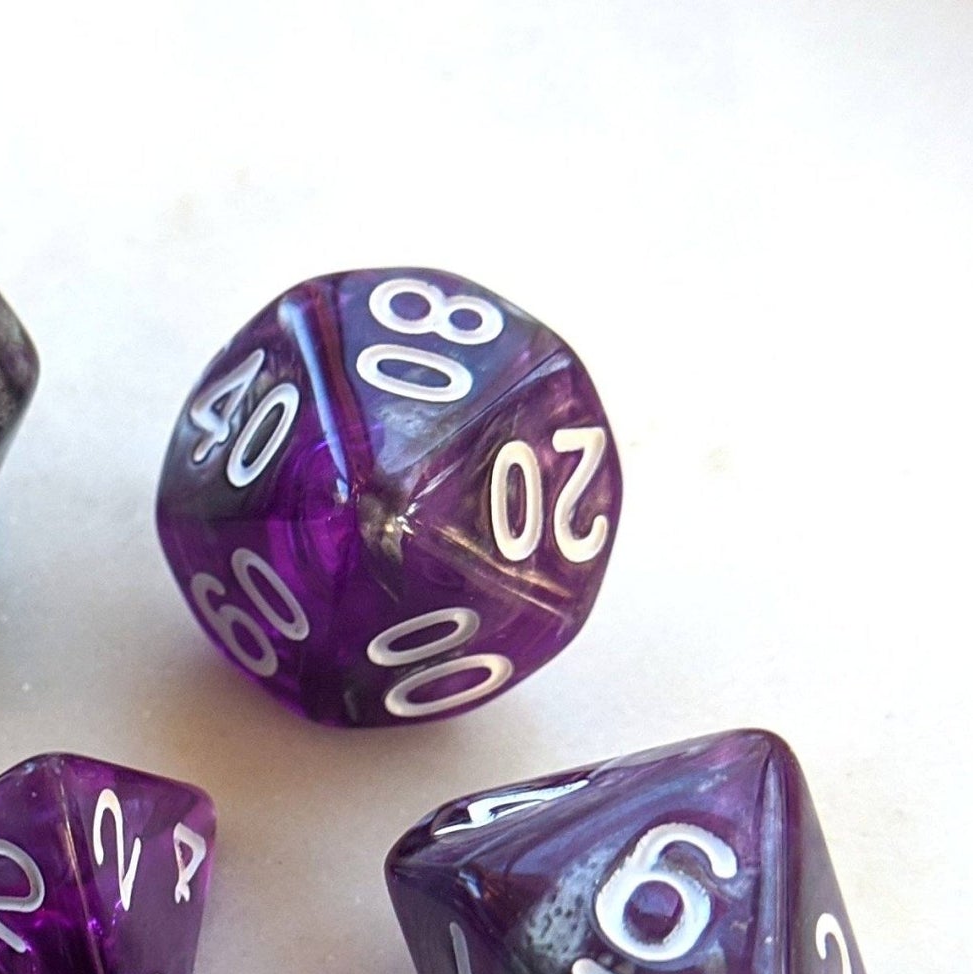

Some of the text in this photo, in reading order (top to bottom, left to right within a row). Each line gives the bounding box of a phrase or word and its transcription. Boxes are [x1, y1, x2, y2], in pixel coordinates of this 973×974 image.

[356, 278, 505, 403] 80
[189, 348, 300, 488] 40
[490, 426, 608, 563] 20
[190, 547, 310, 677] 60
[366, 606, 513, 718] 00
[92, 788, 142, 912] 2
[172, 821, 207, 904] 4
